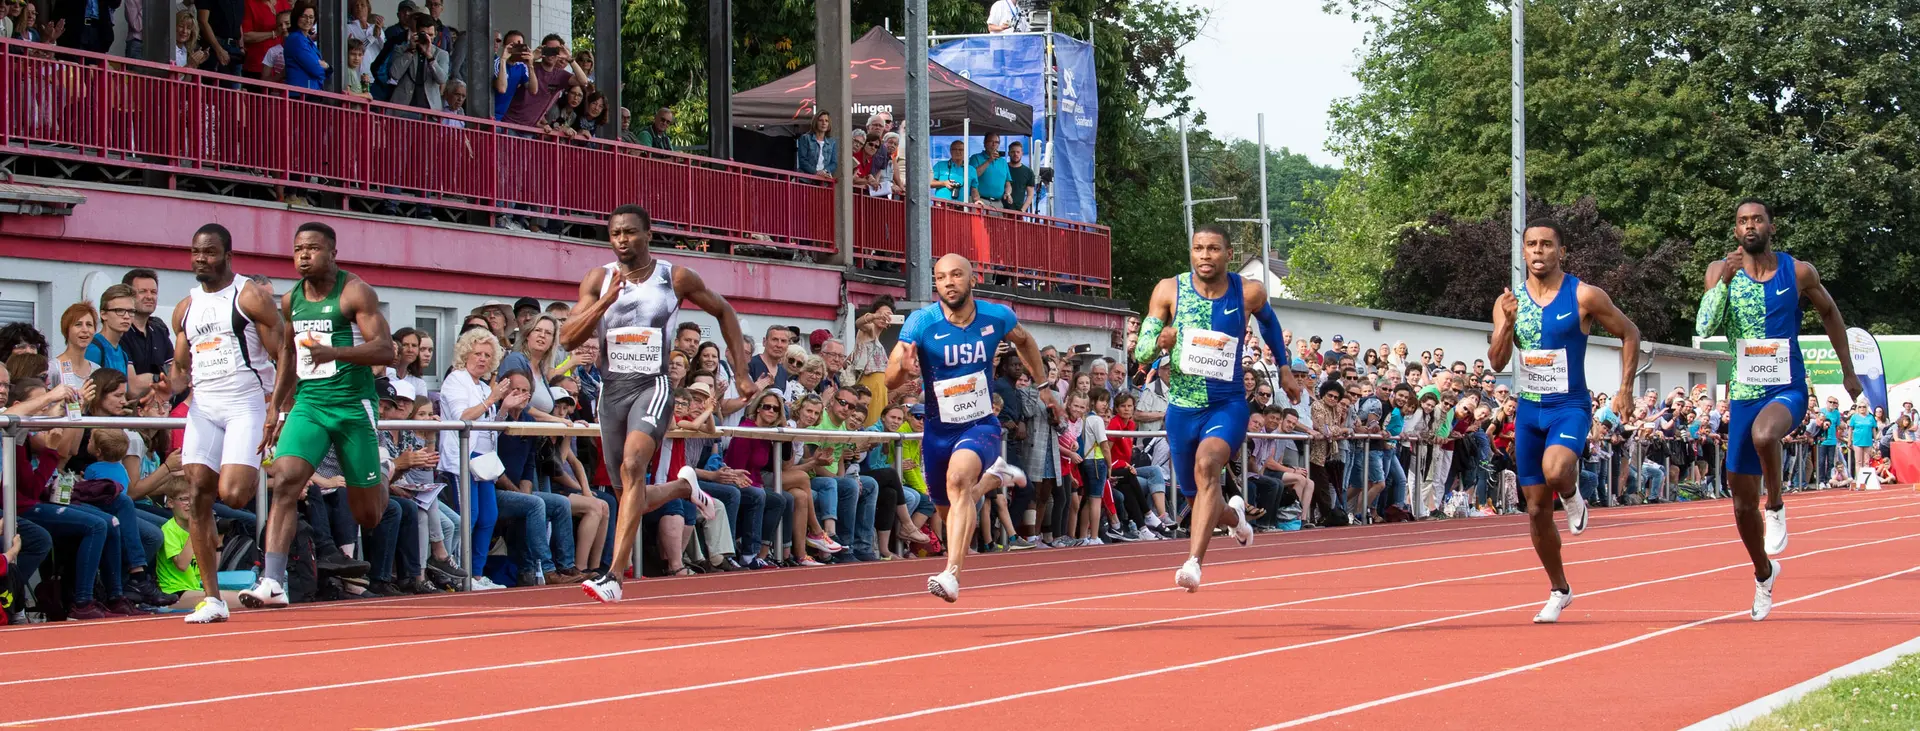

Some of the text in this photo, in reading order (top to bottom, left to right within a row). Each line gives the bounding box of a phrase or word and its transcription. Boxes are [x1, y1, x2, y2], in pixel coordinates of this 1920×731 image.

[851, 103, 893, 115] lingen
[292, 319, 333, 332] NIGERIA
[610, 352, 659, 361] OGUNLEWE
[944, 340, 987, 366] USA
[1188, 354, 1228, 367] RODRIGO
[1189, 367, 1224, 377] REHLINGEN
[1528, 373, 1556, 382] DERICK
[975, 388, 987, 397] 137
[953, 400, 977, 413] GRAY
[950, 409, 985, 422] REHLINGEN
[1863, 472, 1873, 485] 7
